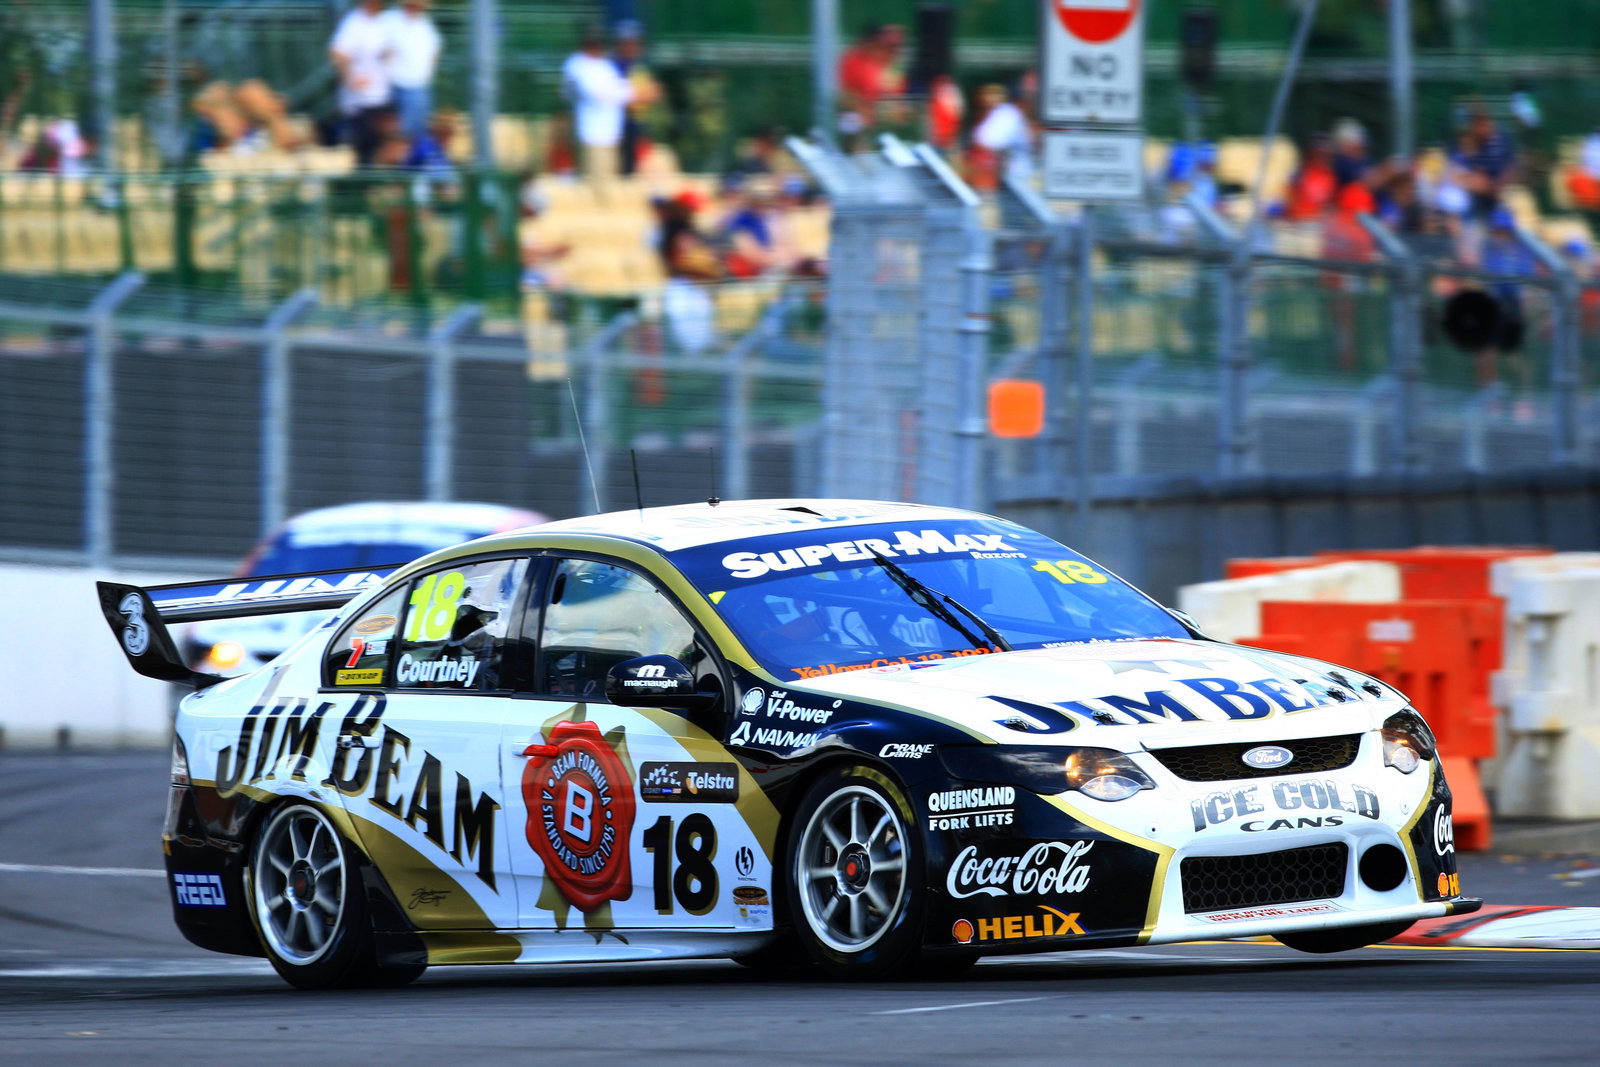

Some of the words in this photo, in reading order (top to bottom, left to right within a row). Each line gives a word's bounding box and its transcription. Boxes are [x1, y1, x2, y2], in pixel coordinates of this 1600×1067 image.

[1070, 53, 1116, 81] NO
[1050, 85, 1132, 111] ENTRY
[721, 529, 1019, 579] SUPER-MAX
[970, 551, 1028, 560] Razors
[1031, 560, 1108, 585] 18
[409, 571, 465, 642] 18
[119, 592, 149, 656] 3
[345, 638, 365, 668] 7
[345, 672, 379, 681] DUNLOP
[397, 653, 480, 688] Courtney
[624, 678, 679, 689] macnaught
[770, 690, 787, 699] Shell
[989, 695, 1199, 734] JIM
[1172, 676, 1385, 722] BEA
[766, 697, 833, 725] V-Power
[752, 727, 822, 749] NAVMAN
[1254, 749, 1283, 765] Ford
[215, 674, 336, 798] JIM
[321, 691, 501, 895] BEAM
[551, 751, 577, 780] BEAM
[577, 752, 612, 806] FORMULA
[687, 771, 735, 790] Telstra
[541, 789, 555, 800] A
[928, 786, 1016, 812] QUEENSLAND
[1190, 784, 1265, 832] ICE
[1272, 778, 1380, 820] COLD
[564, 780, 594, 843] B
[929, 818, 970, 831] FORK
[975, 812, 1014, 827] LIFTS
[1240, 815, 1344, 832] CANS
[541, 805, 578, 871] STANDARD
[599, 823, 616, 857] 1795
[579, 855, 606, 875] SINCE
[643, 812, 719, 916] 18
[946, 840, 1095, 899] Coca-Cola
[173, 873, 227, 906] REED
[976, 904, 1091, 941] HELIX
[1204, 911, 1241, 920] WHERE
[1210, 913, 1255, 923] DRAW
[1256, 910, 1285, 918] THE
